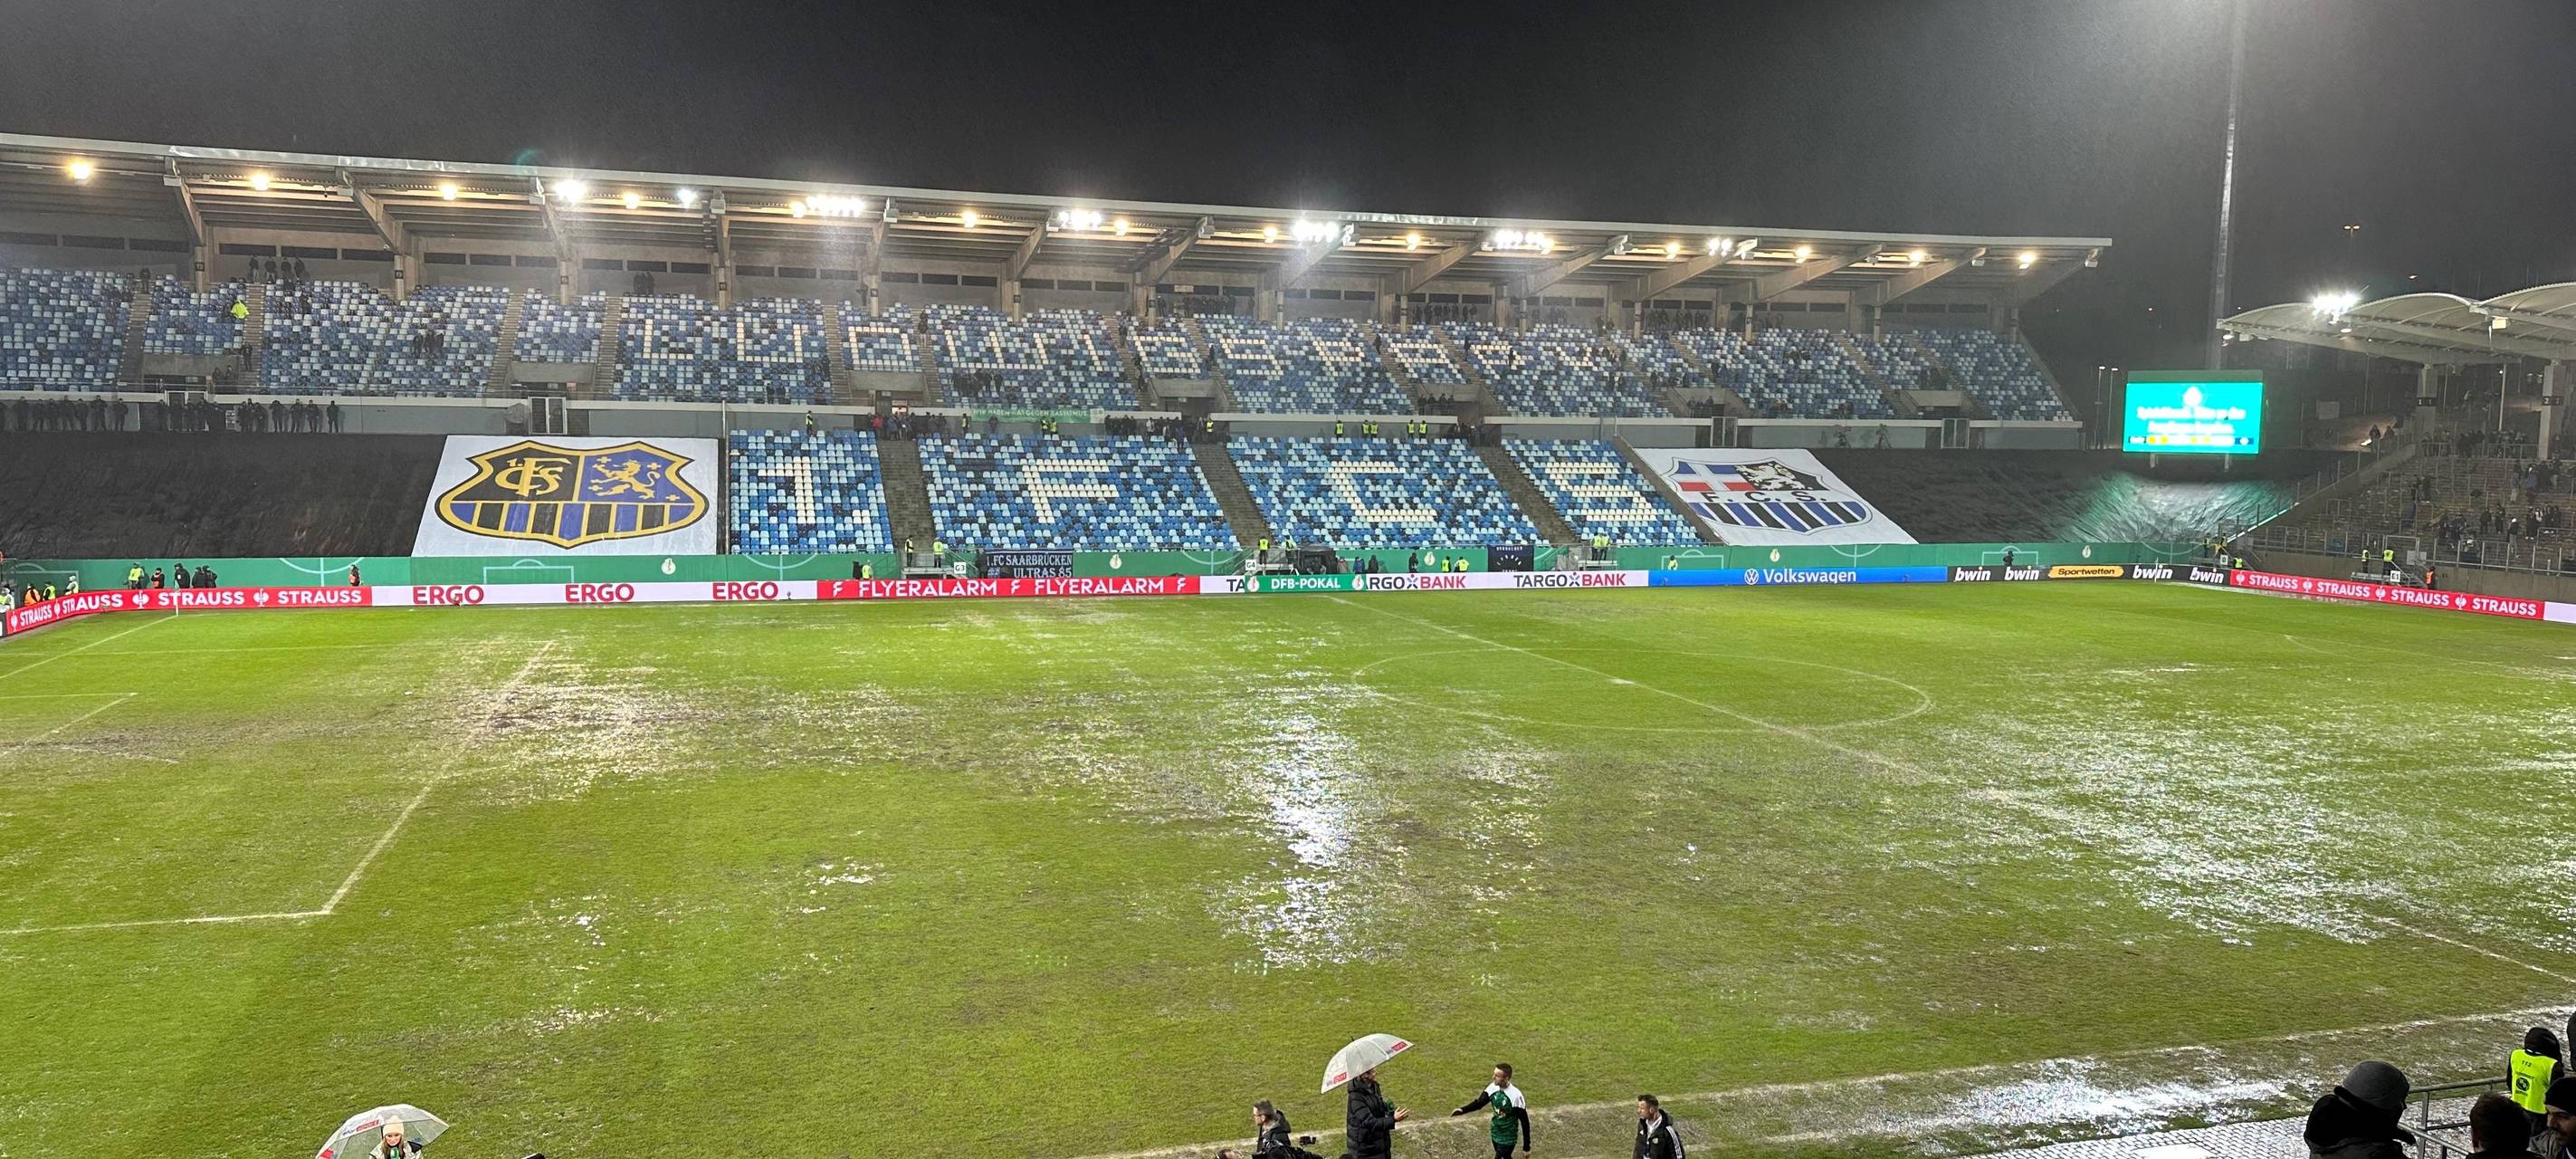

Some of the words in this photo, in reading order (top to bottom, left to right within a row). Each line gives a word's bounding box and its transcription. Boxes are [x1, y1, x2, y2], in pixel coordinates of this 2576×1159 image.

[1006, 553, 1072, 567] SAARBRÜCKEN
[1014, 568, 1055, 579] ULTRAS
[1058, 566, 1072, 578] 85
[1763, 568, 1856, 585] Volkswagen
[1955, 566, 1991, 582] bwin
[2004, 564, 2039, 580] bwin
[2057, 566, 2114, 579] Sportwetten
[2132, 565, 2173, 581] bwin
[2190, 567, 2224, 584] bwin
[712, 580, 778, 601] ERGO
[859, 580, 997, 598] FLYERALARM
[1035, 578, 1164, 596] FLYERALARM
[1271, 577, 1340, 590] DFB-POKAL
[2248, 573, 2298, 591] STRAUSS
[2317, 580, 2371, 599] STRAUSS
[158, 589, 244, 607] STRAUSS
[277, 589, 362, 605] STRAUSS
[413, 585, 484, 606] ERGO
[565, 583, 634, 603] ERGO
[2390, 588, 2450, 608] STRAUSS
[62, 592, 123, 615] STRAUSS
[2472, 597, 2537, 618] STRAUSS
[20, 603, 52, 627] STRAUSS
